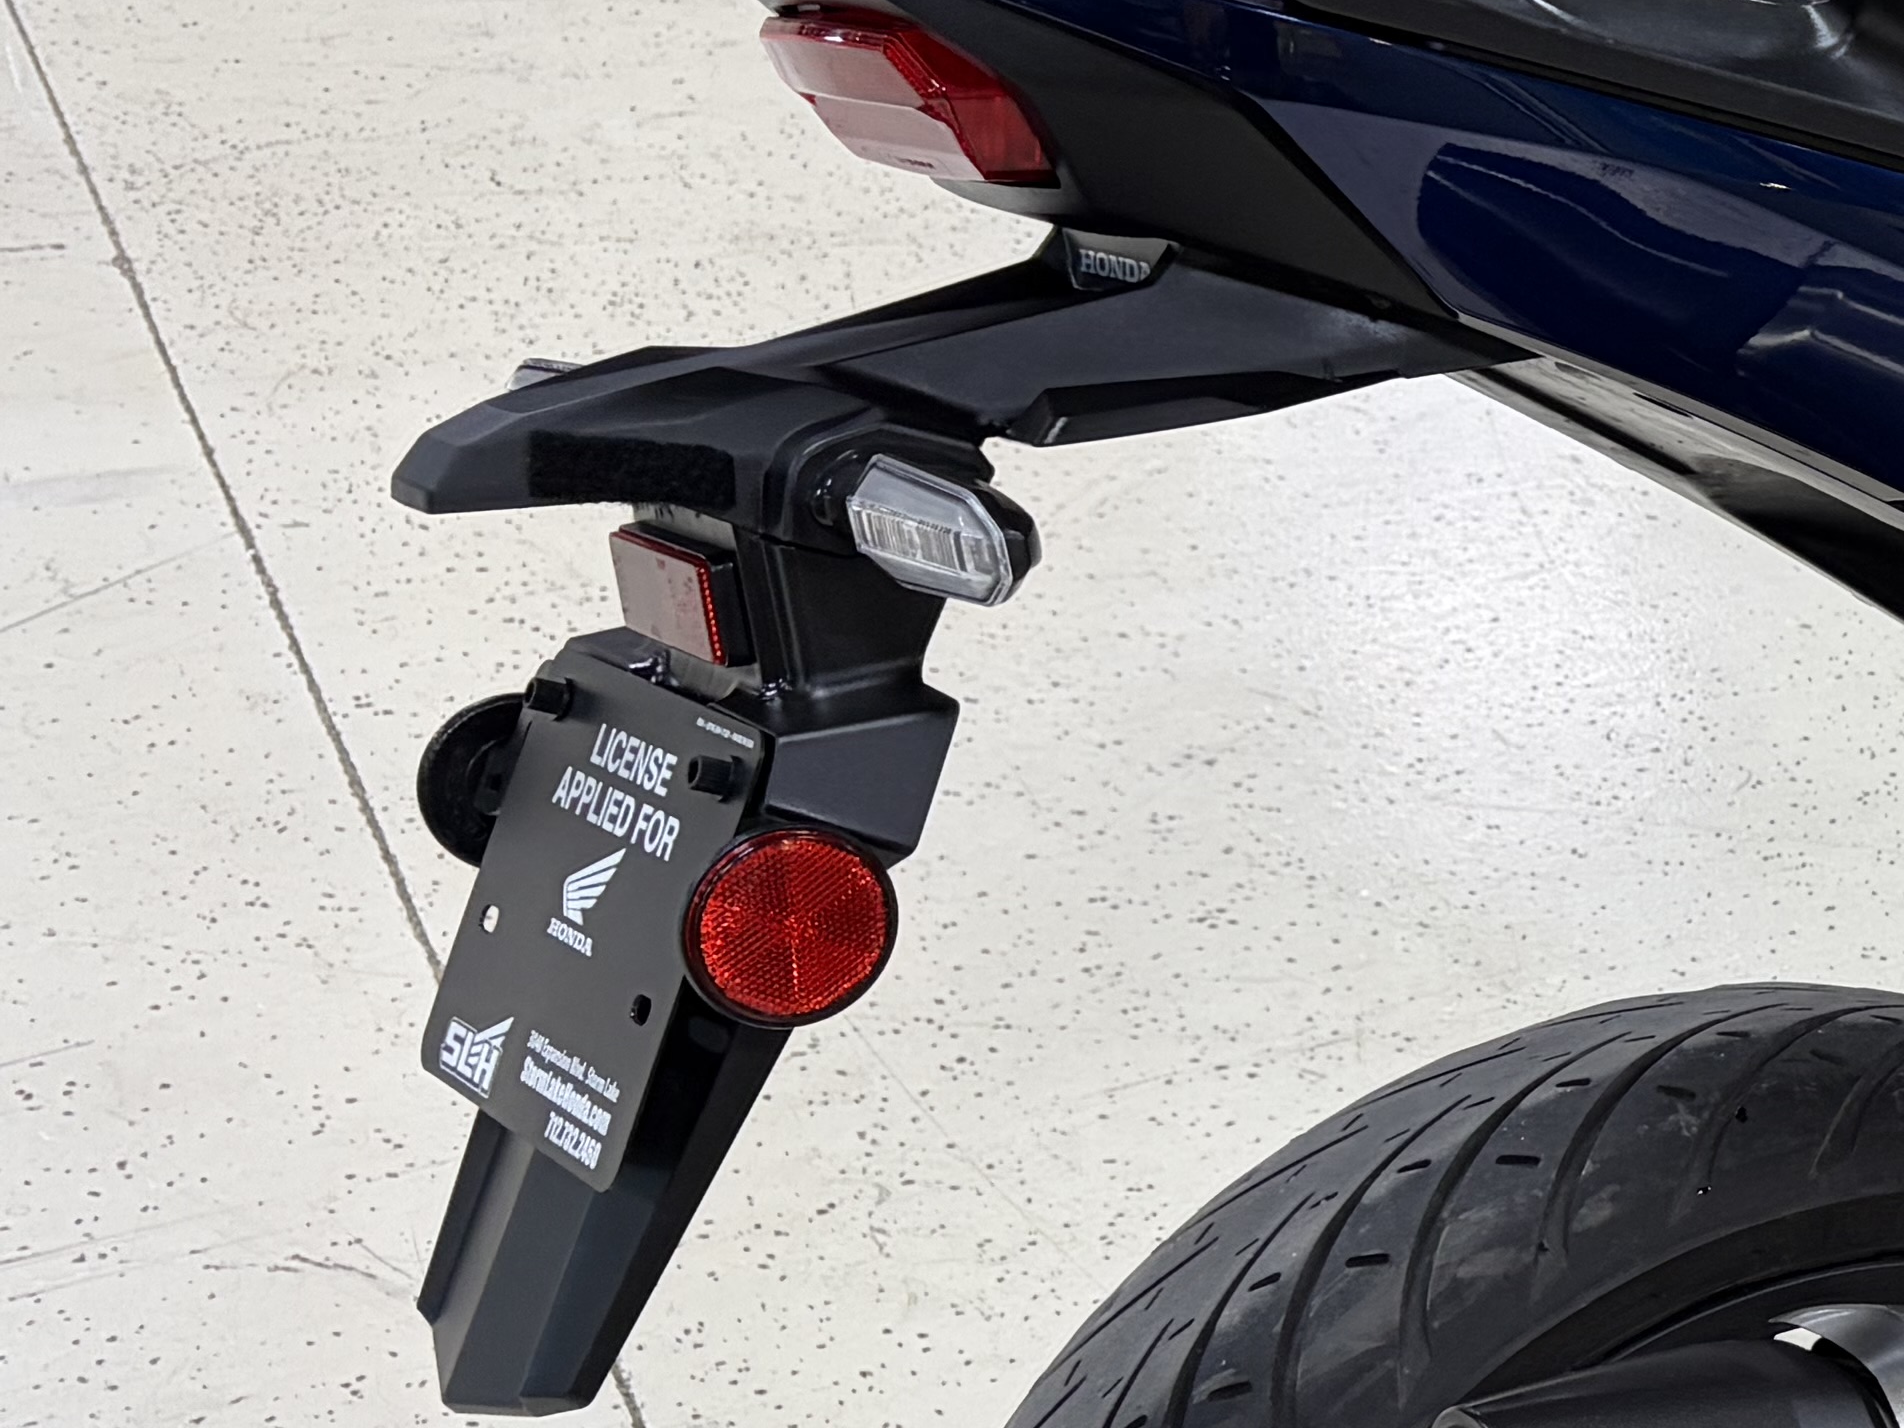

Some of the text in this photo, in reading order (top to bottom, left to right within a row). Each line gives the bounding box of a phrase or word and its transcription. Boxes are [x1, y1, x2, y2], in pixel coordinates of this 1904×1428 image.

[590, 723, 678, 797] LICENSE
[551, 766, 681, 861] APPLIED FOR
[546, 917, 594, 956] HONDA
